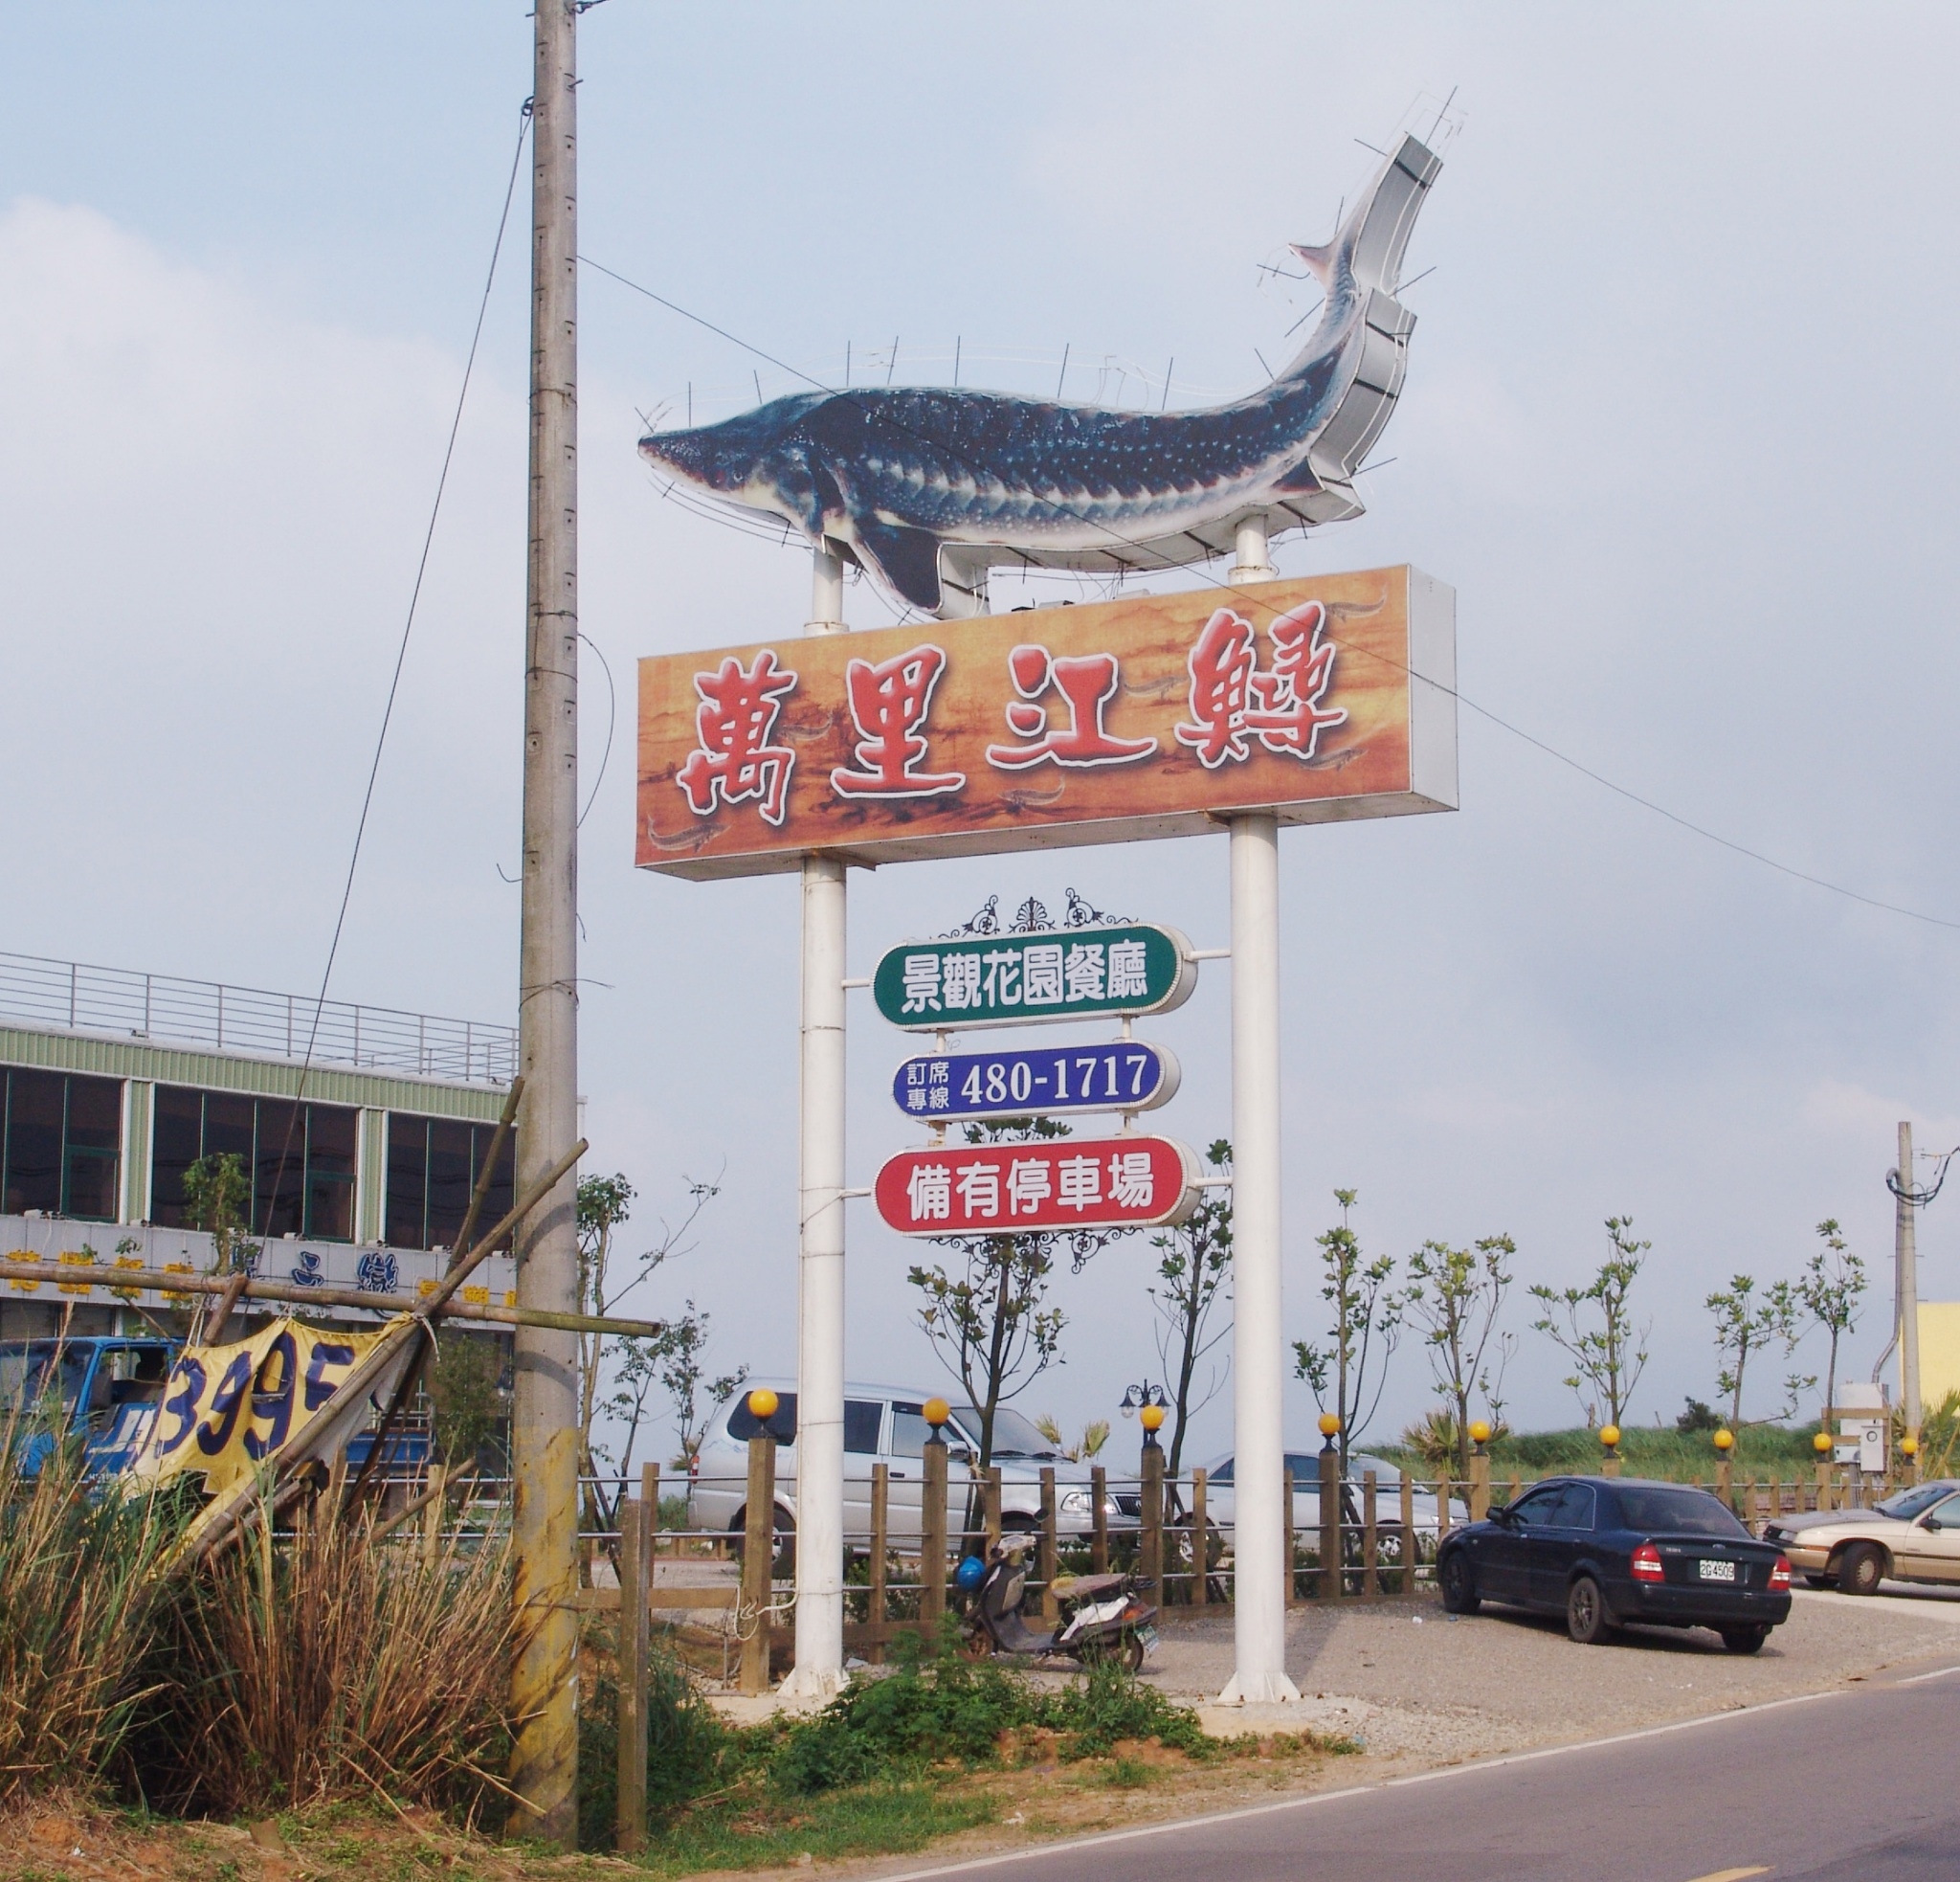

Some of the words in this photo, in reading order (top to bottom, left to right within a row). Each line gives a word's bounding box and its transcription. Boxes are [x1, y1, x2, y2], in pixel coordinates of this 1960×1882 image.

[901, 938, 1148, 1013] 景觀花園餐廳
[906, 1061, 950, 1086] 訂席
[906, 1086, 950, 1111] 專線
[961, 1054, 1148, 1105] 480-1717
[906, 1152, 1154, 1222] 備有停車場
